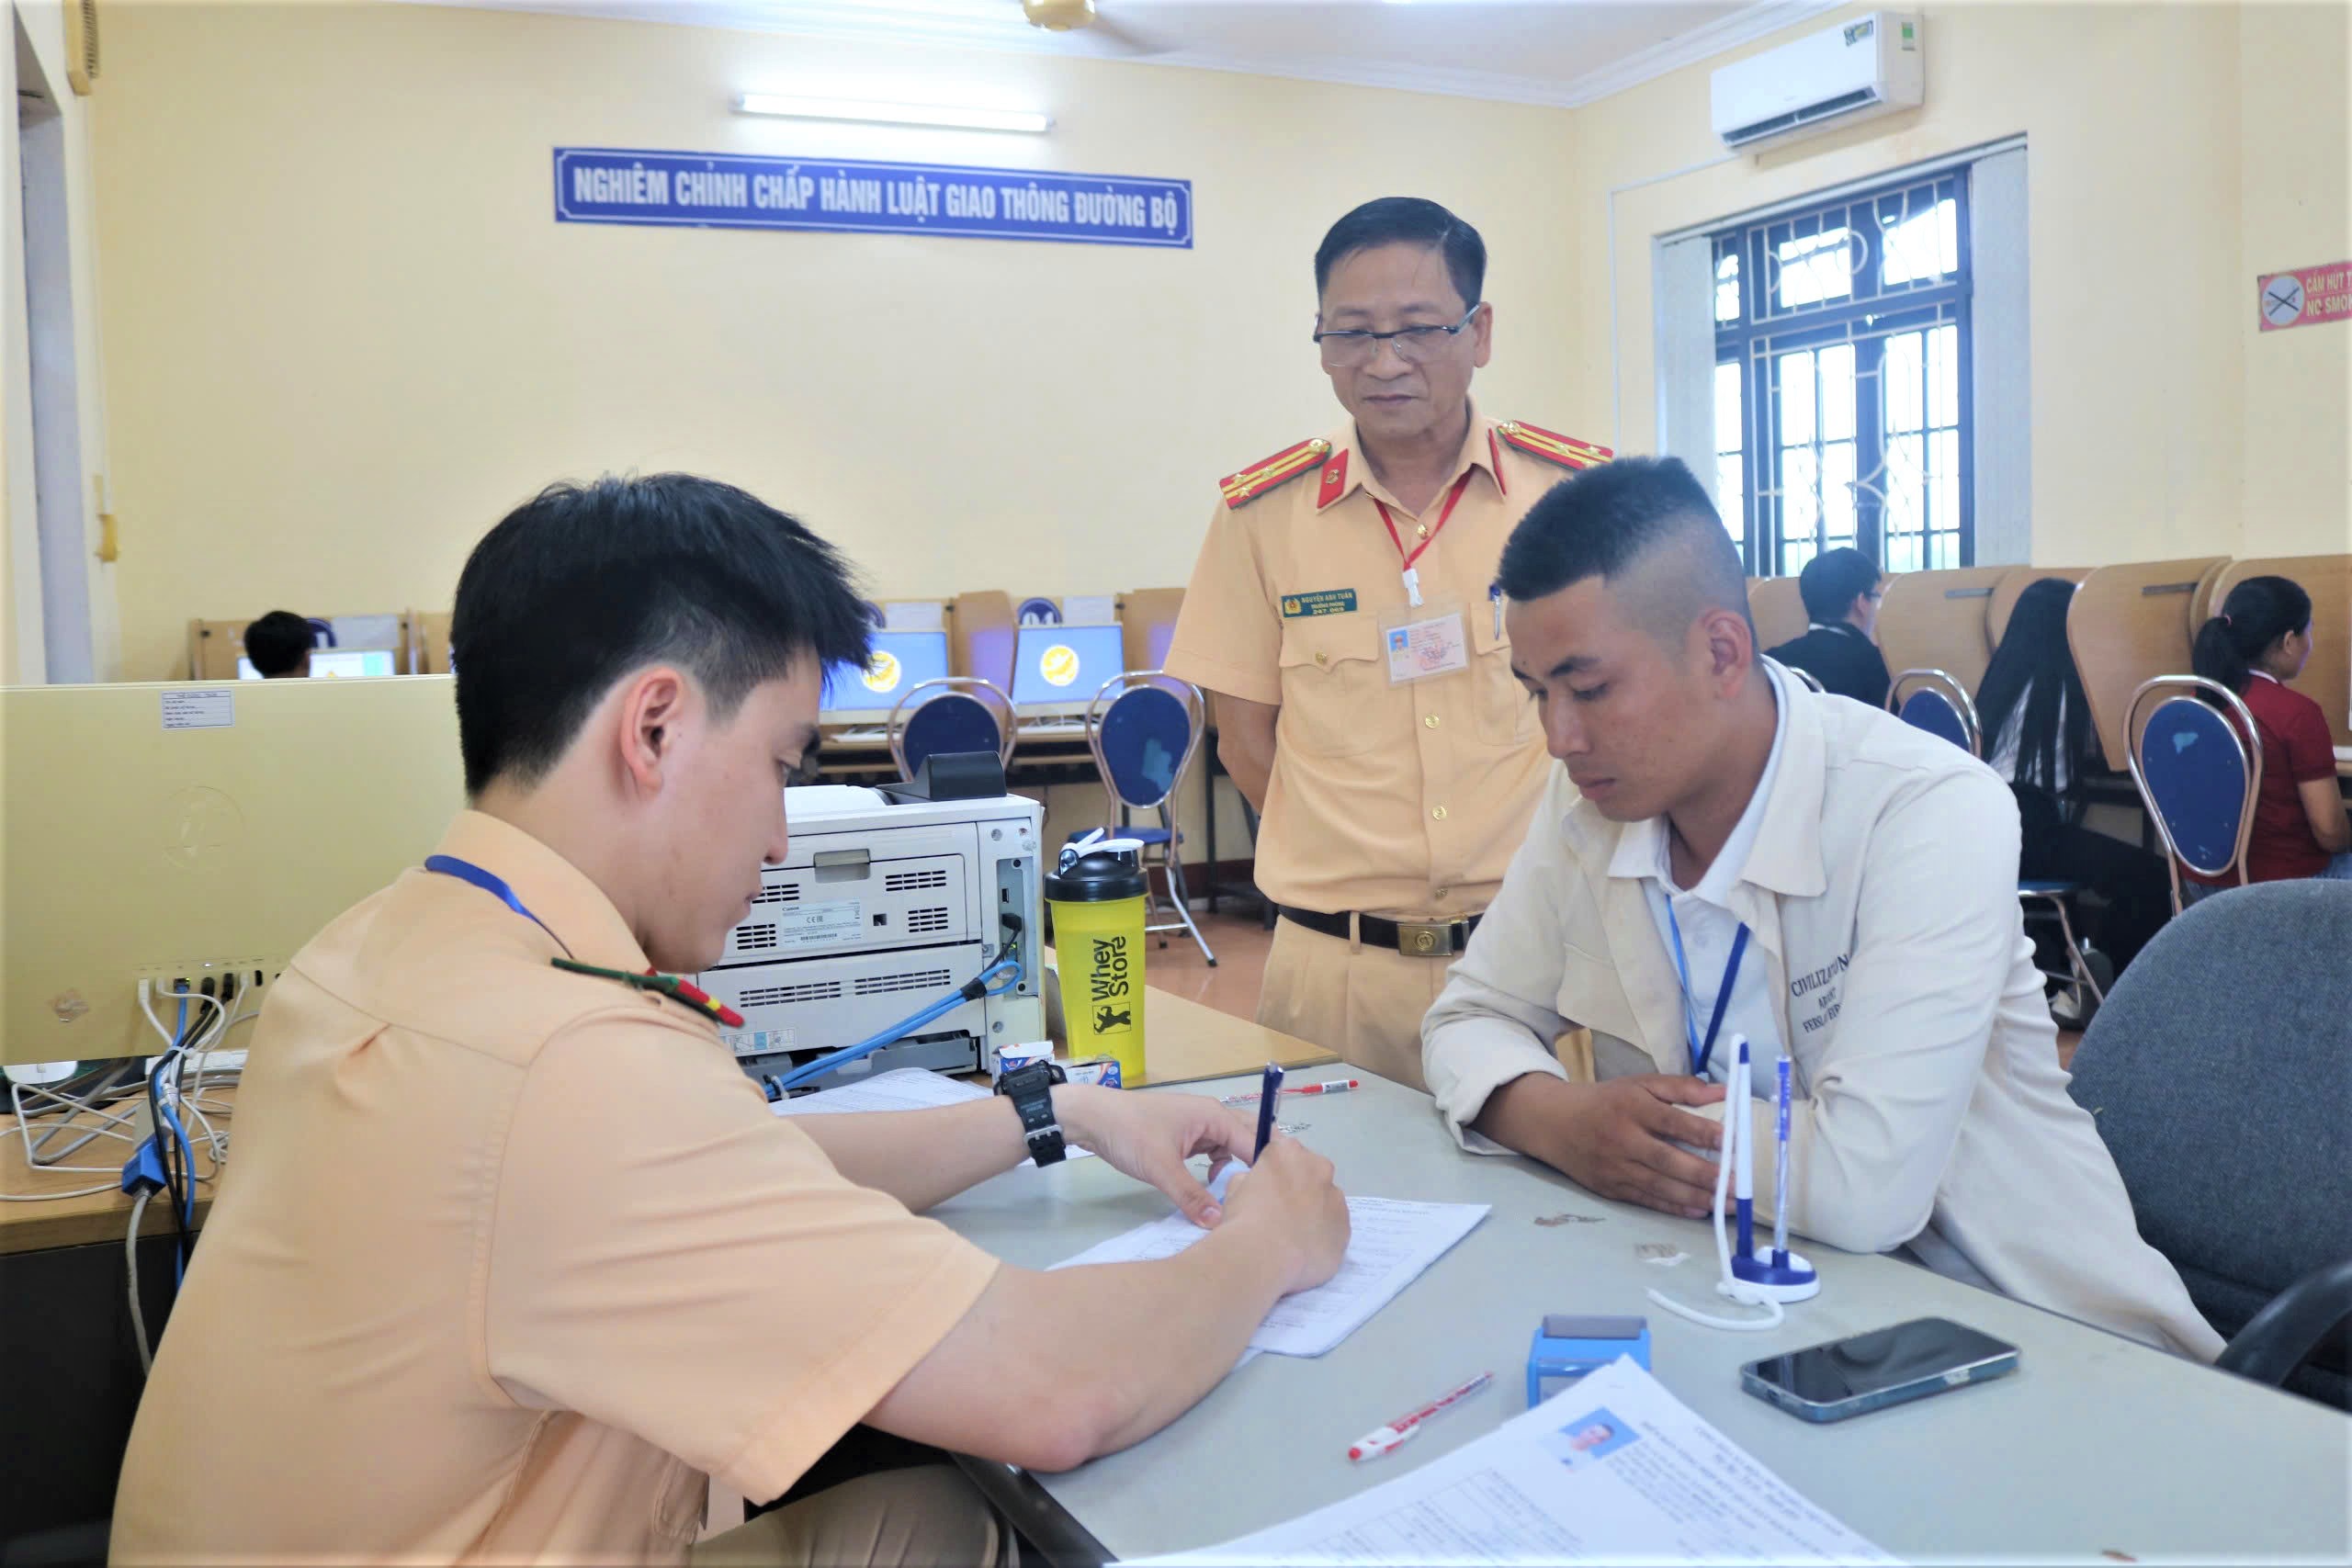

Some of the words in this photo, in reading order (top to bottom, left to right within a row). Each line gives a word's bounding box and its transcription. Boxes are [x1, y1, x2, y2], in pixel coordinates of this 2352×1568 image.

[573, 163, 670, 205] NGHIÊM
[674, 161, 748, 208] CHỈNH
[752, 164, 815, 210] CHẤP
[820, 169, 882, 213] HÀNH
[887, 175, 941, 223] LUẬT
[945, 185, 996, 220] GIAO
[1001, 182, 1070, 223] THÔNG
[1150, 191, 1178, 235] BỘ
[1091, 939, 1111, 1001] Whey
[1109, 936, 1129, 997] Store
